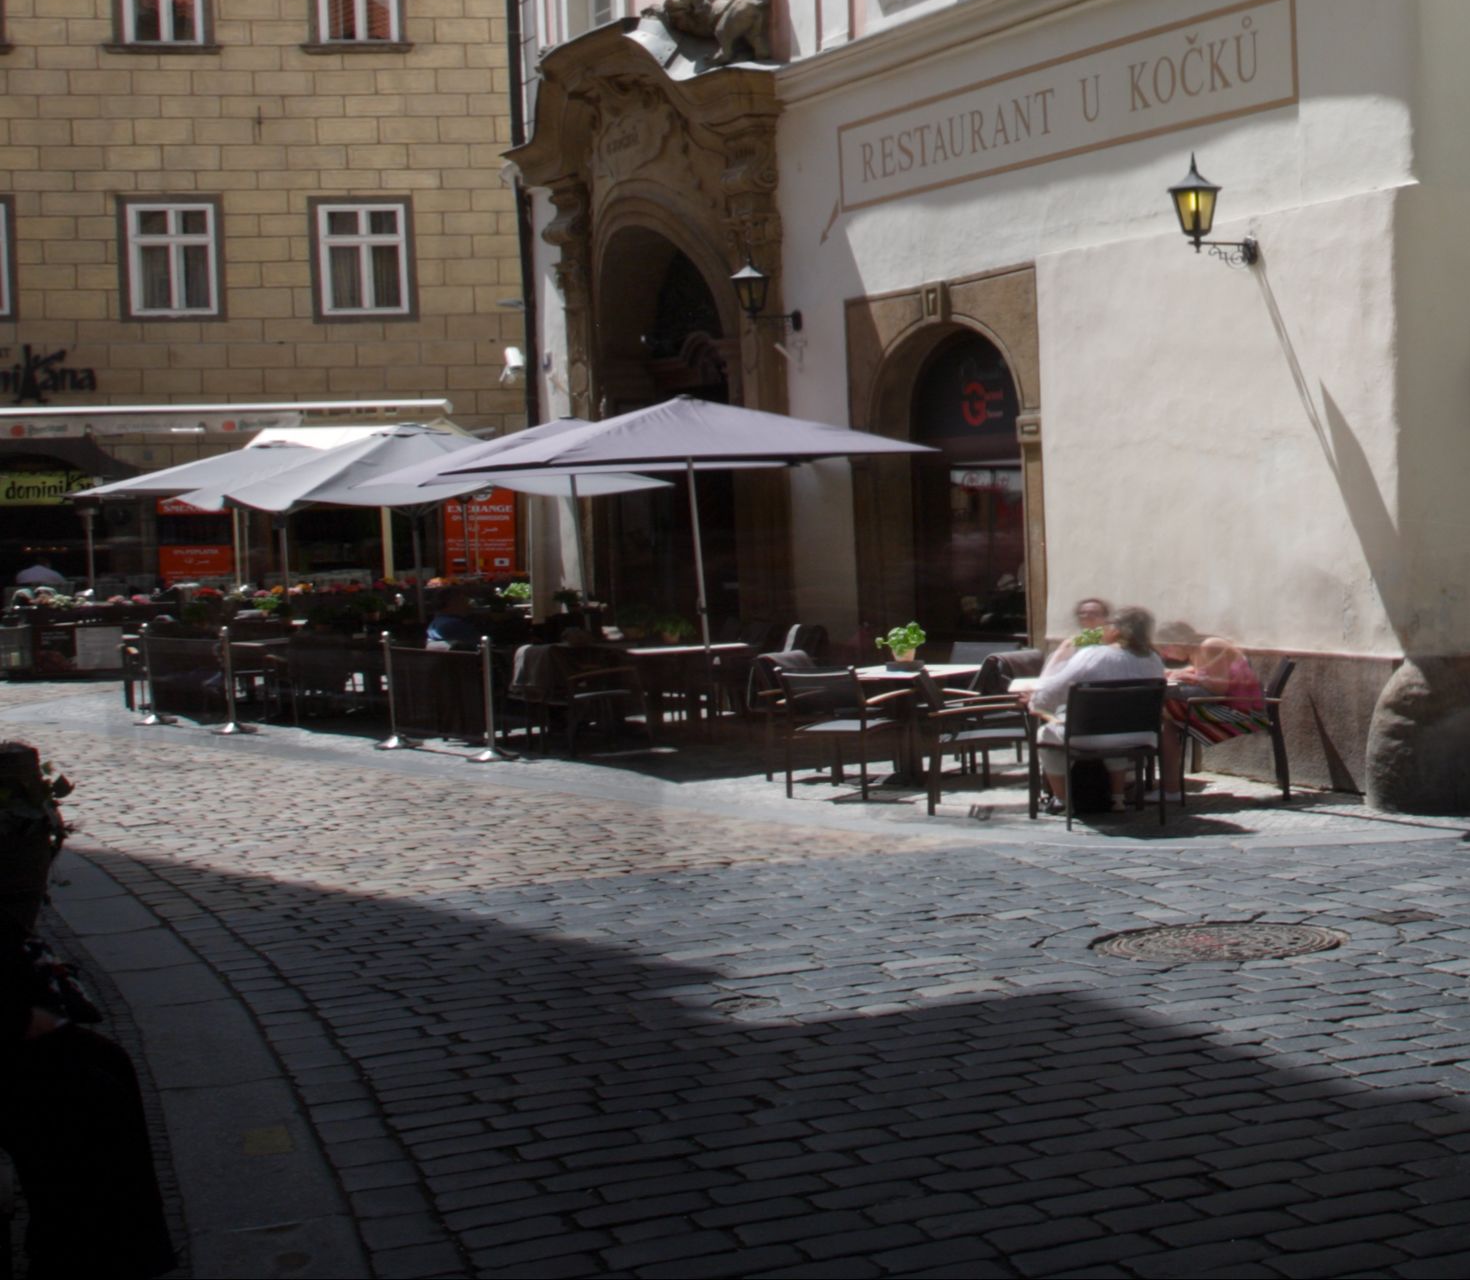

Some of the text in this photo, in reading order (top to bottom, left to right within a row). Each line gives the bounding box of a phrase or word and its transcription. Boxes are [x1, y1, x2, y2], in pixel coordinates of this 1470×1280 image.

[860, 15, 1260, 184] RESTAURANT U KOČKŮ
